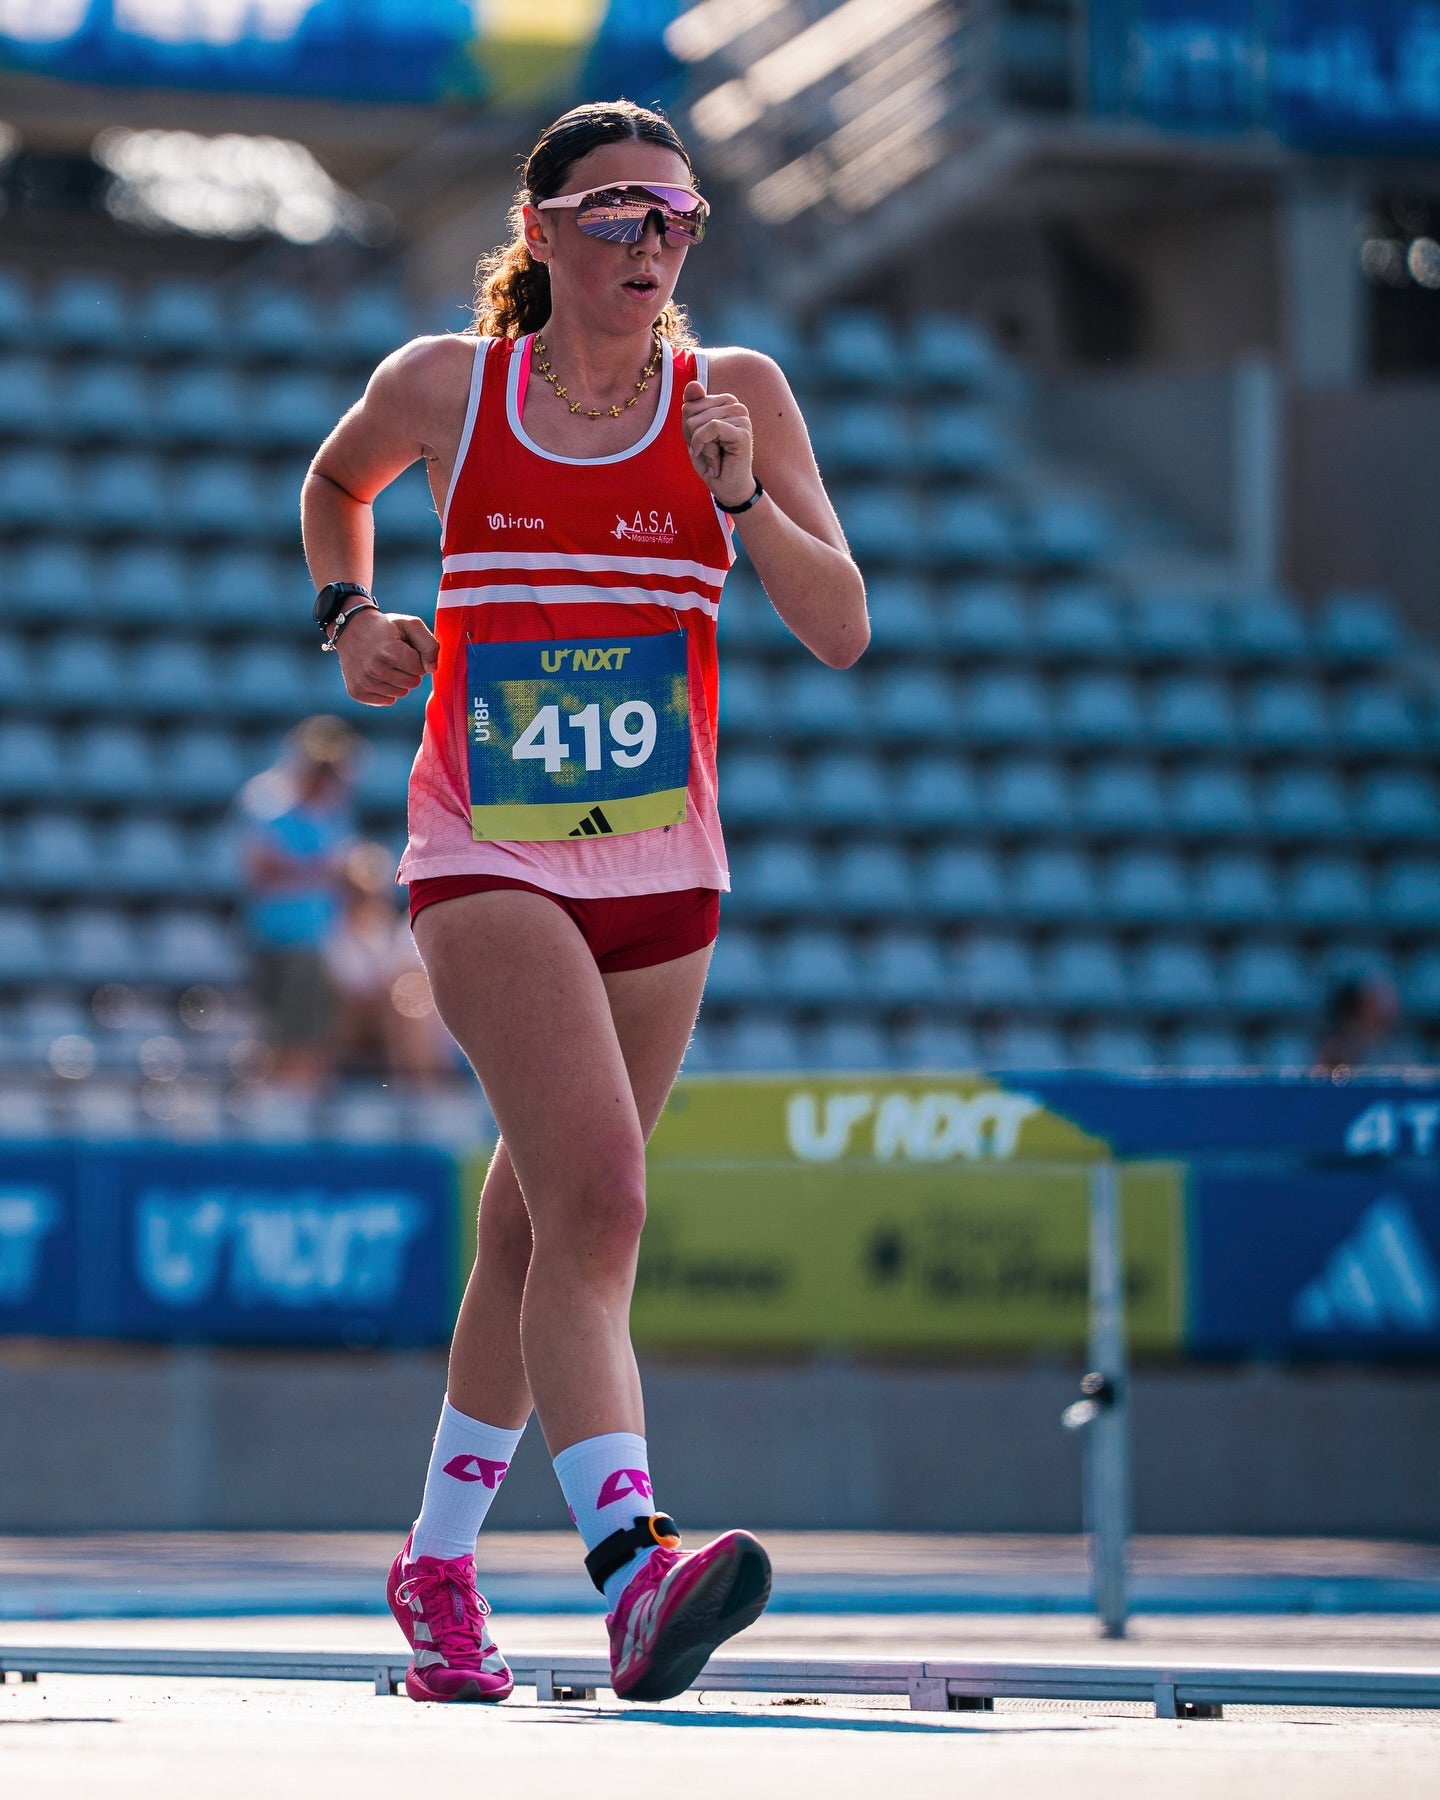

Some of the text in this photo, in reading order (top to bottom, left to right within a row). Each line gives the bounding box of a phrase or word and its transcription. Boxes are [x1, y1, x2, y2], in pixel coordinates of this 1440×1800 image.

[509, 512, 545, 530] i-run
[632, 510, 678, 534] A.S.A.
[474, 697, 490, 742] U18F
[512, 700, 657, 772] 419
